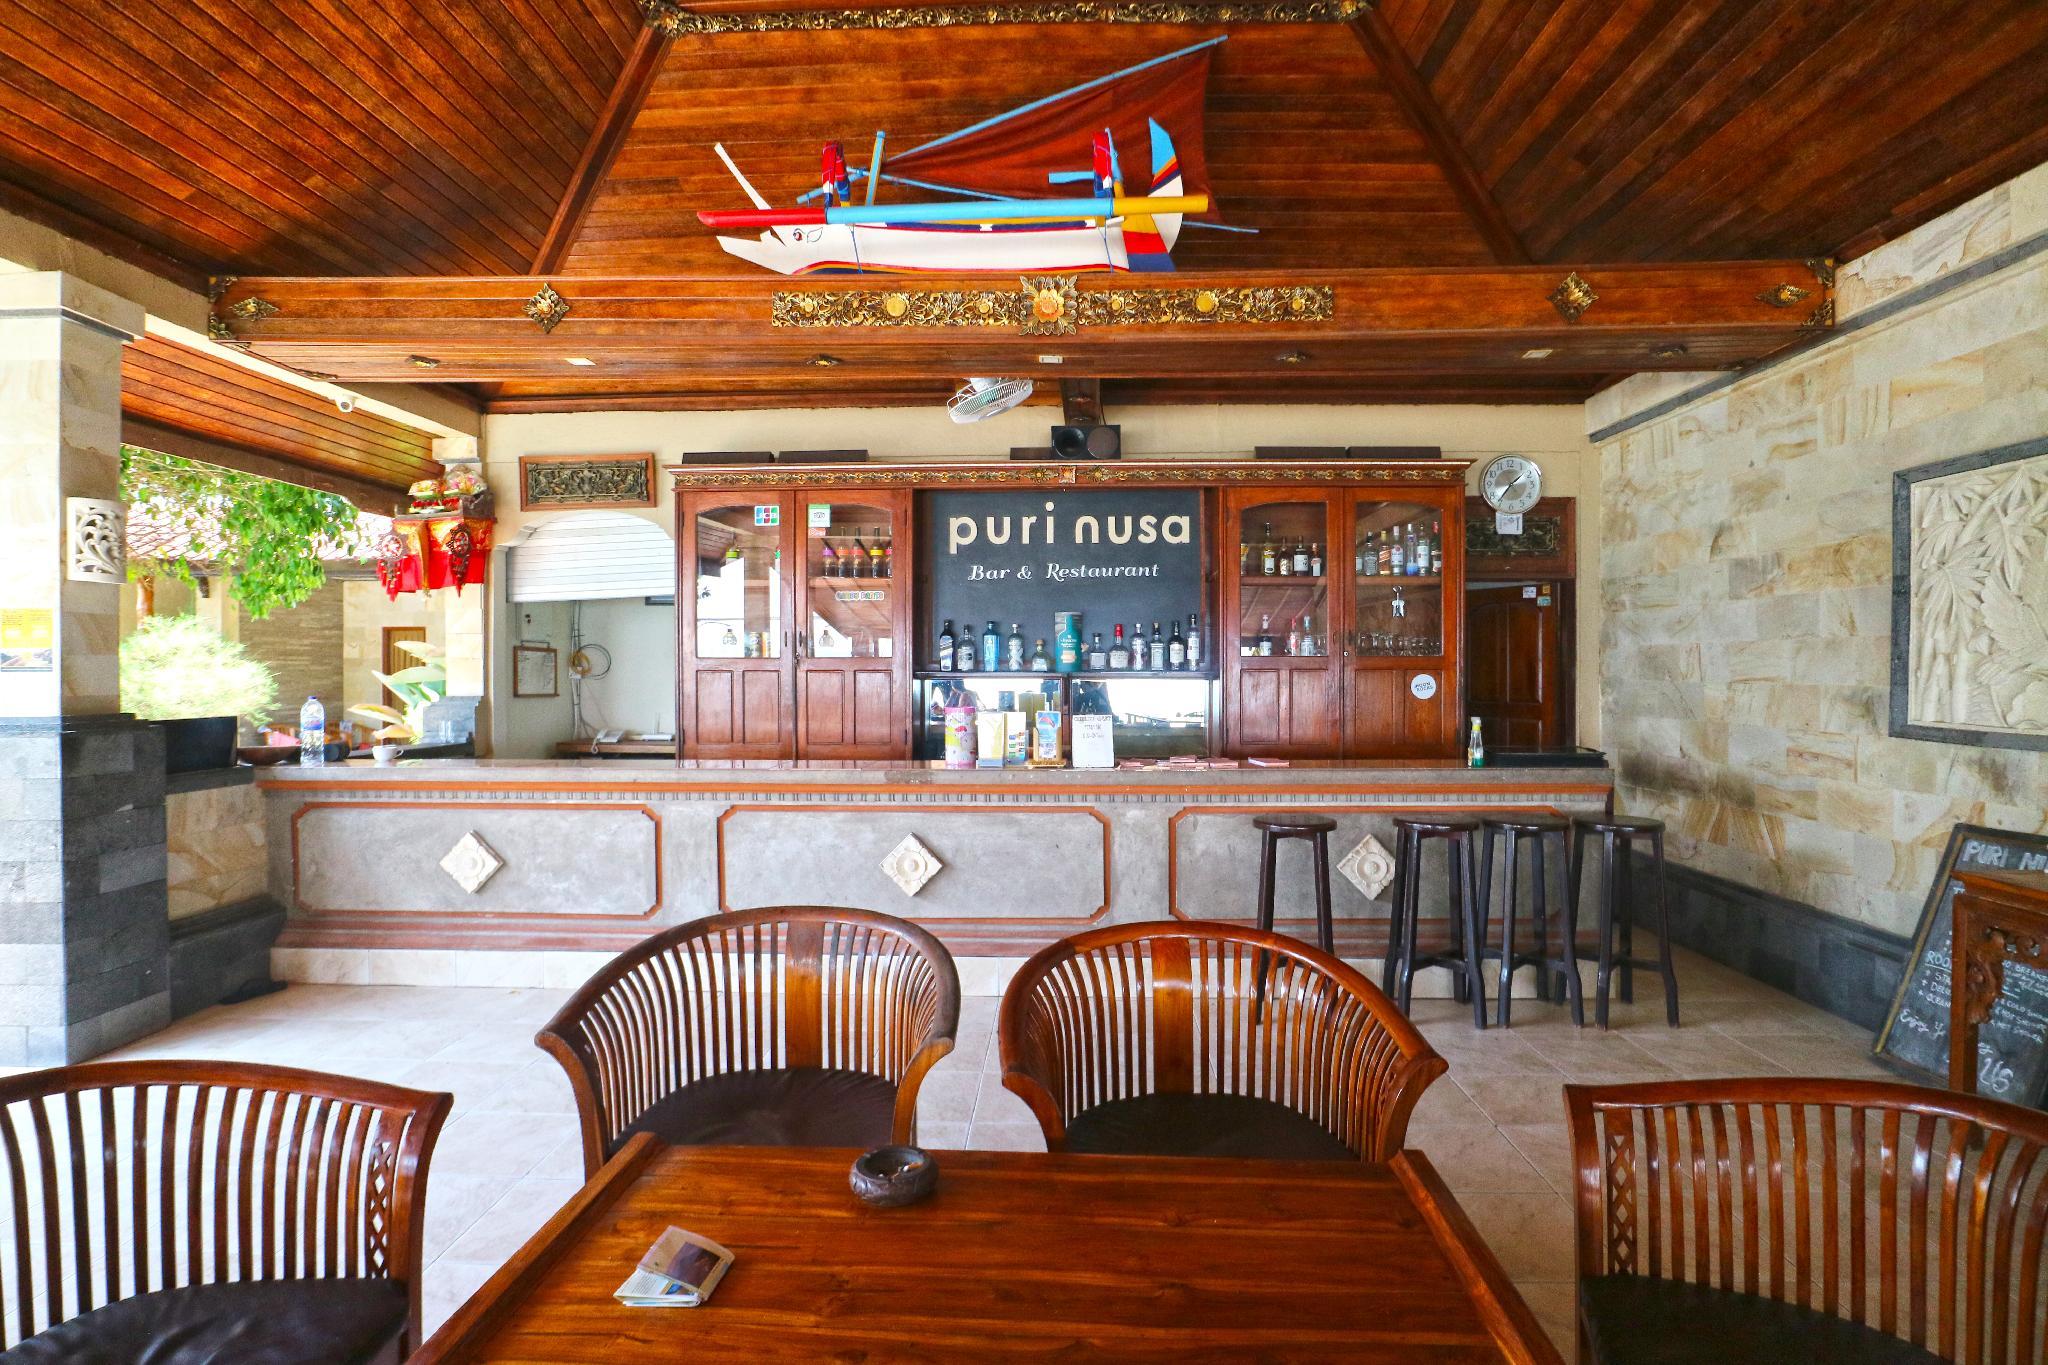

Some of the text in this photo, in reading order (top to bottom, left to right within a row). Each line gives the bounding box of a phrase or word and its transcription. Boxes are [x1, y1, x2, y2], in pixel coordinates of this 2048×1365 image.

[1506, 460, 1514, 468] 12
[1489, 470, 1497, 478] 10
[1527, 470, 1532, 478] 2
[1530, 481, 1535, 489] 3
[1508, 503, 1514, 511] 6
[1520, 500, 1525, 508] 5
[949, 501, 1190, 554] puri nusa
[967, 562, 1160, 582] Bar & Restaurant
[1962, 838, 2009, 868] PURI
[1926, 950, 1952, 968] ROO
